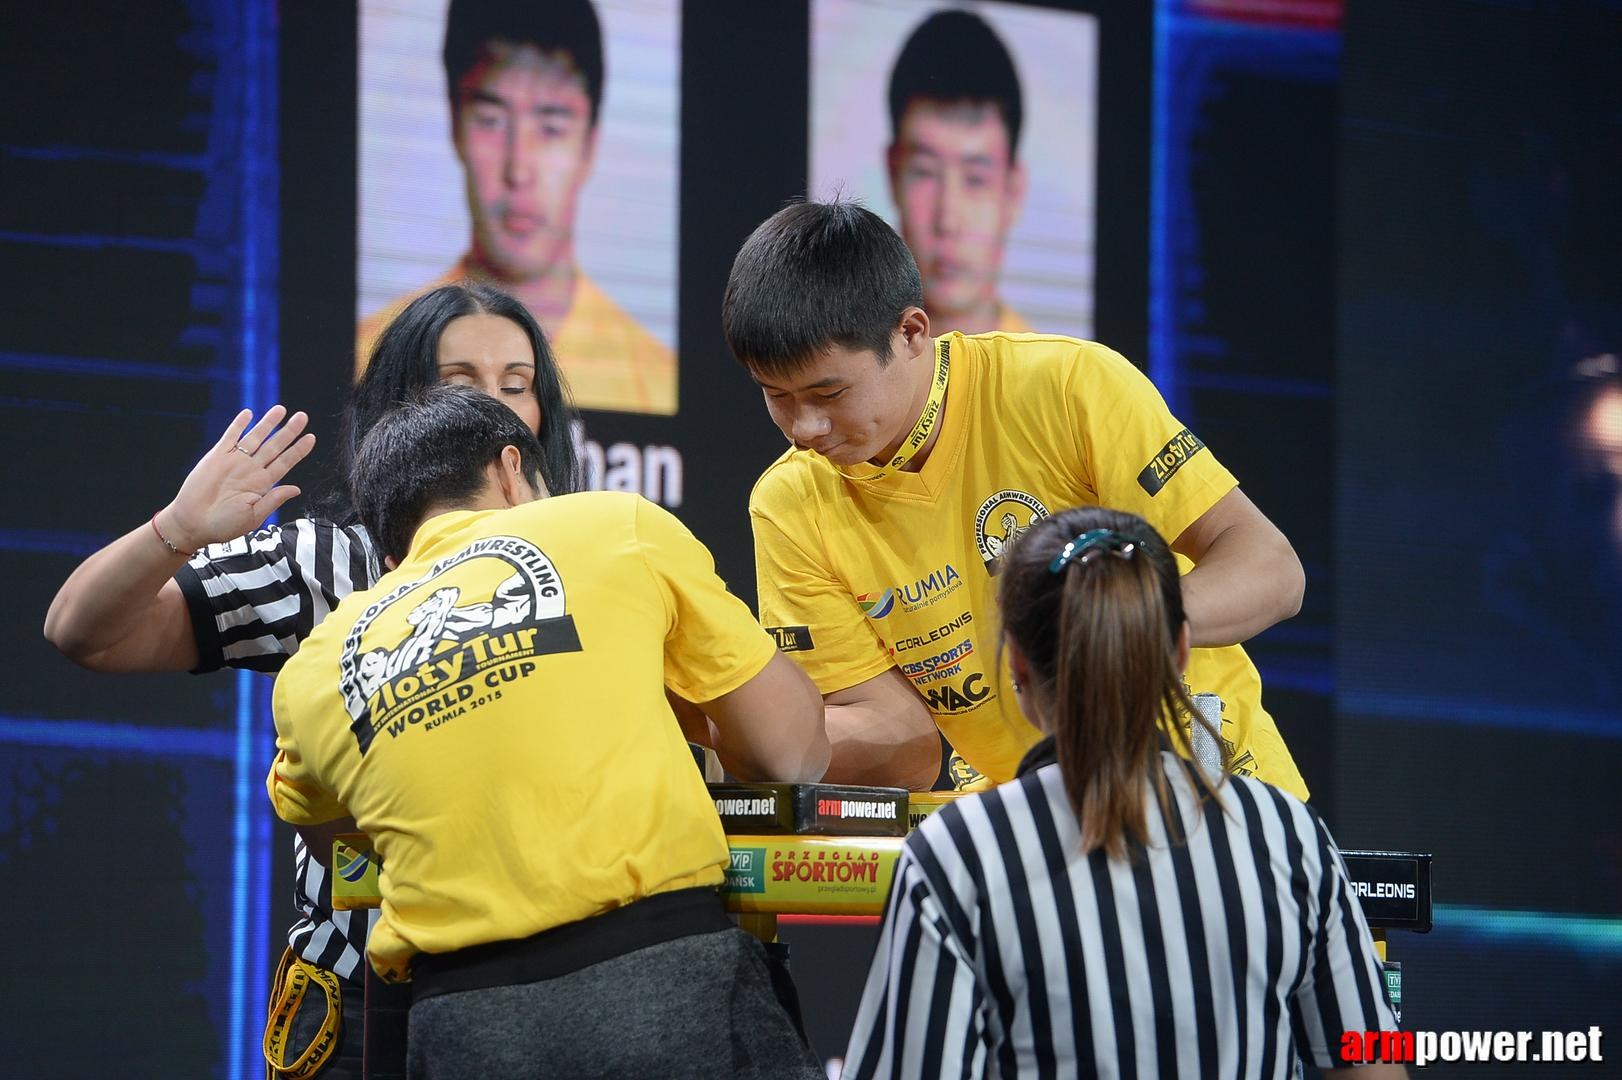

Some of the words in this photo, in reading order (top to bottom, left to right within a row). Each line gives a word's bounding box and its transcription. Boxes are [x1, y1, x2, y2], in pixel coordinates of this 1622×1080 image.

[569, 419, 682, 507] han
[1000, 491, 1049, 518] ARMWRESTLIN
[896, 564, 959, 605] RUMIA
[896, 611, 973, 652] CORLEONIS
[475, 648, 535, 670] TOURNAMENT
[915, 663, 962, 686] NETWORK
[387, 683, 474, 739] WORLD
[484, 661, 536, 688] CUP
[424, 707, 467, 731] RUMIA
[470, 690, 503, 710] 2015
[715, 796, 776, 816] ower.net
[817, 798, 897, 820] armpower.net
[772, 860, 879, 883] SPORTOWY
[1350, 881, 1415, 899] ORLEONIS
